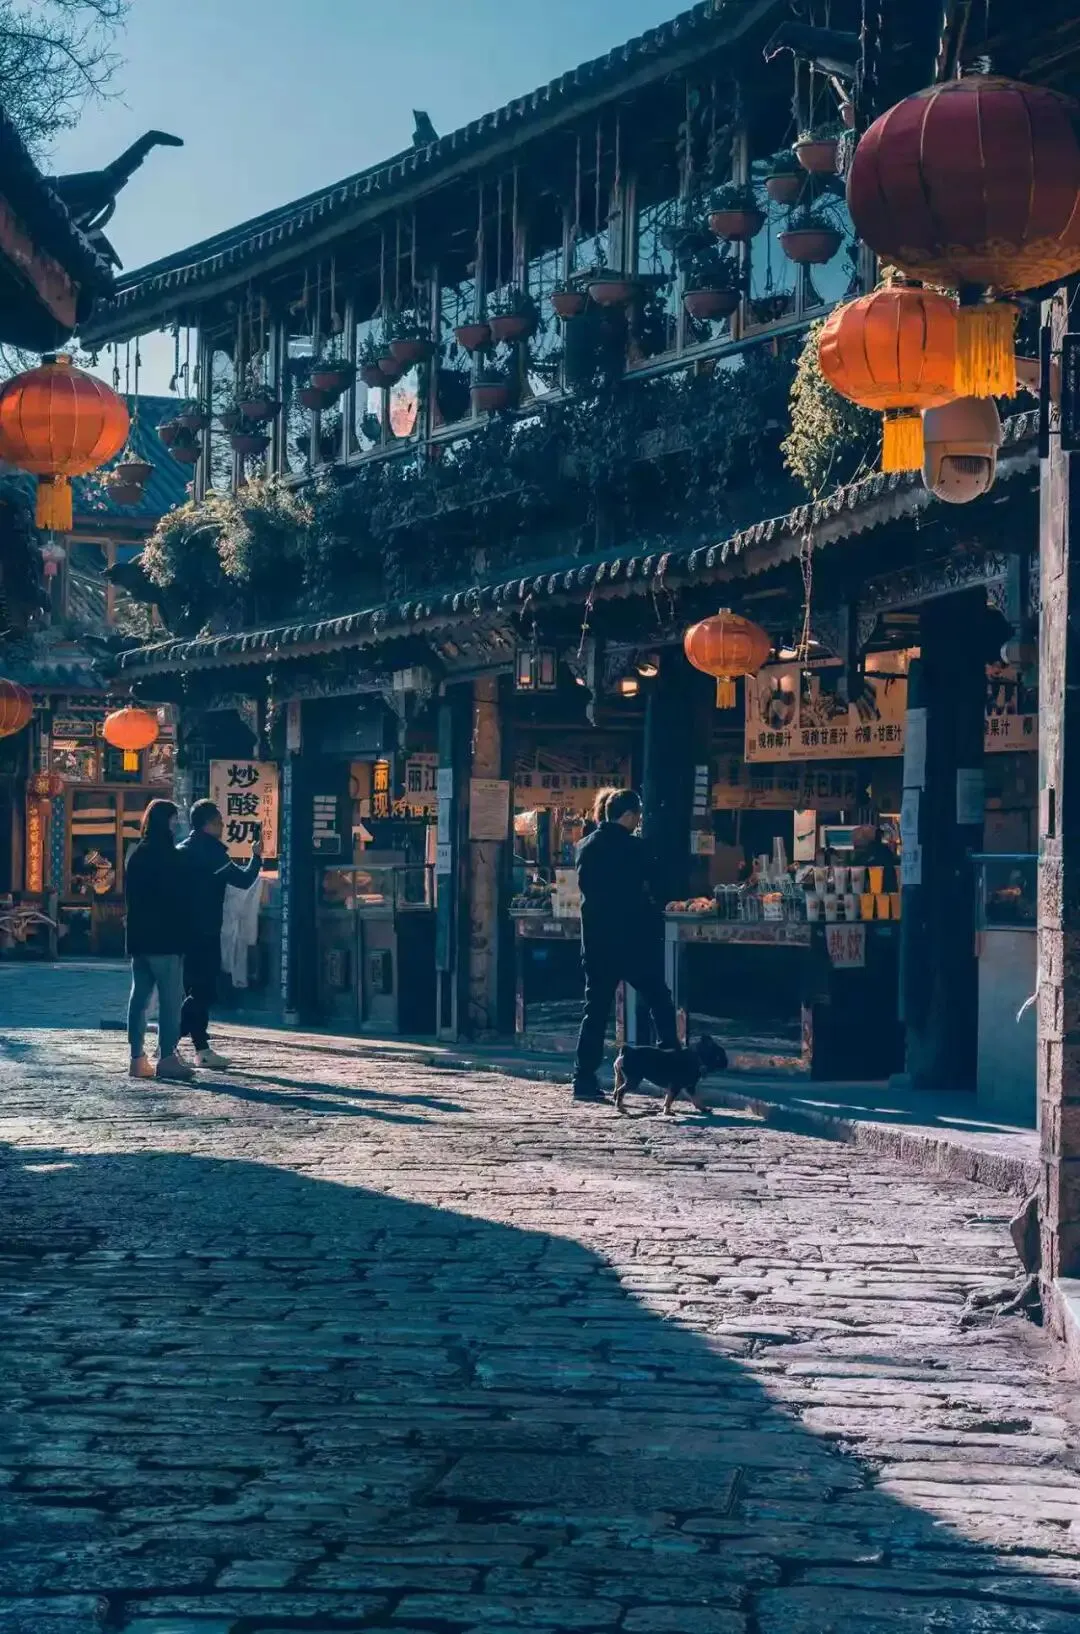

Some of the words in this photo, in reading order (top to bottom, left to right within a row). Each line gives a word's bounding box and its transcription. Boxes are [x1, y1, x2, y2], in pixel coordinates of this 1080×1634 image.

[801, 728, 848, 745] 现榨甘蔗汁
[227, 763, 263, 843] 炒酸奶
[830, 929, 862, 961] 热饮
